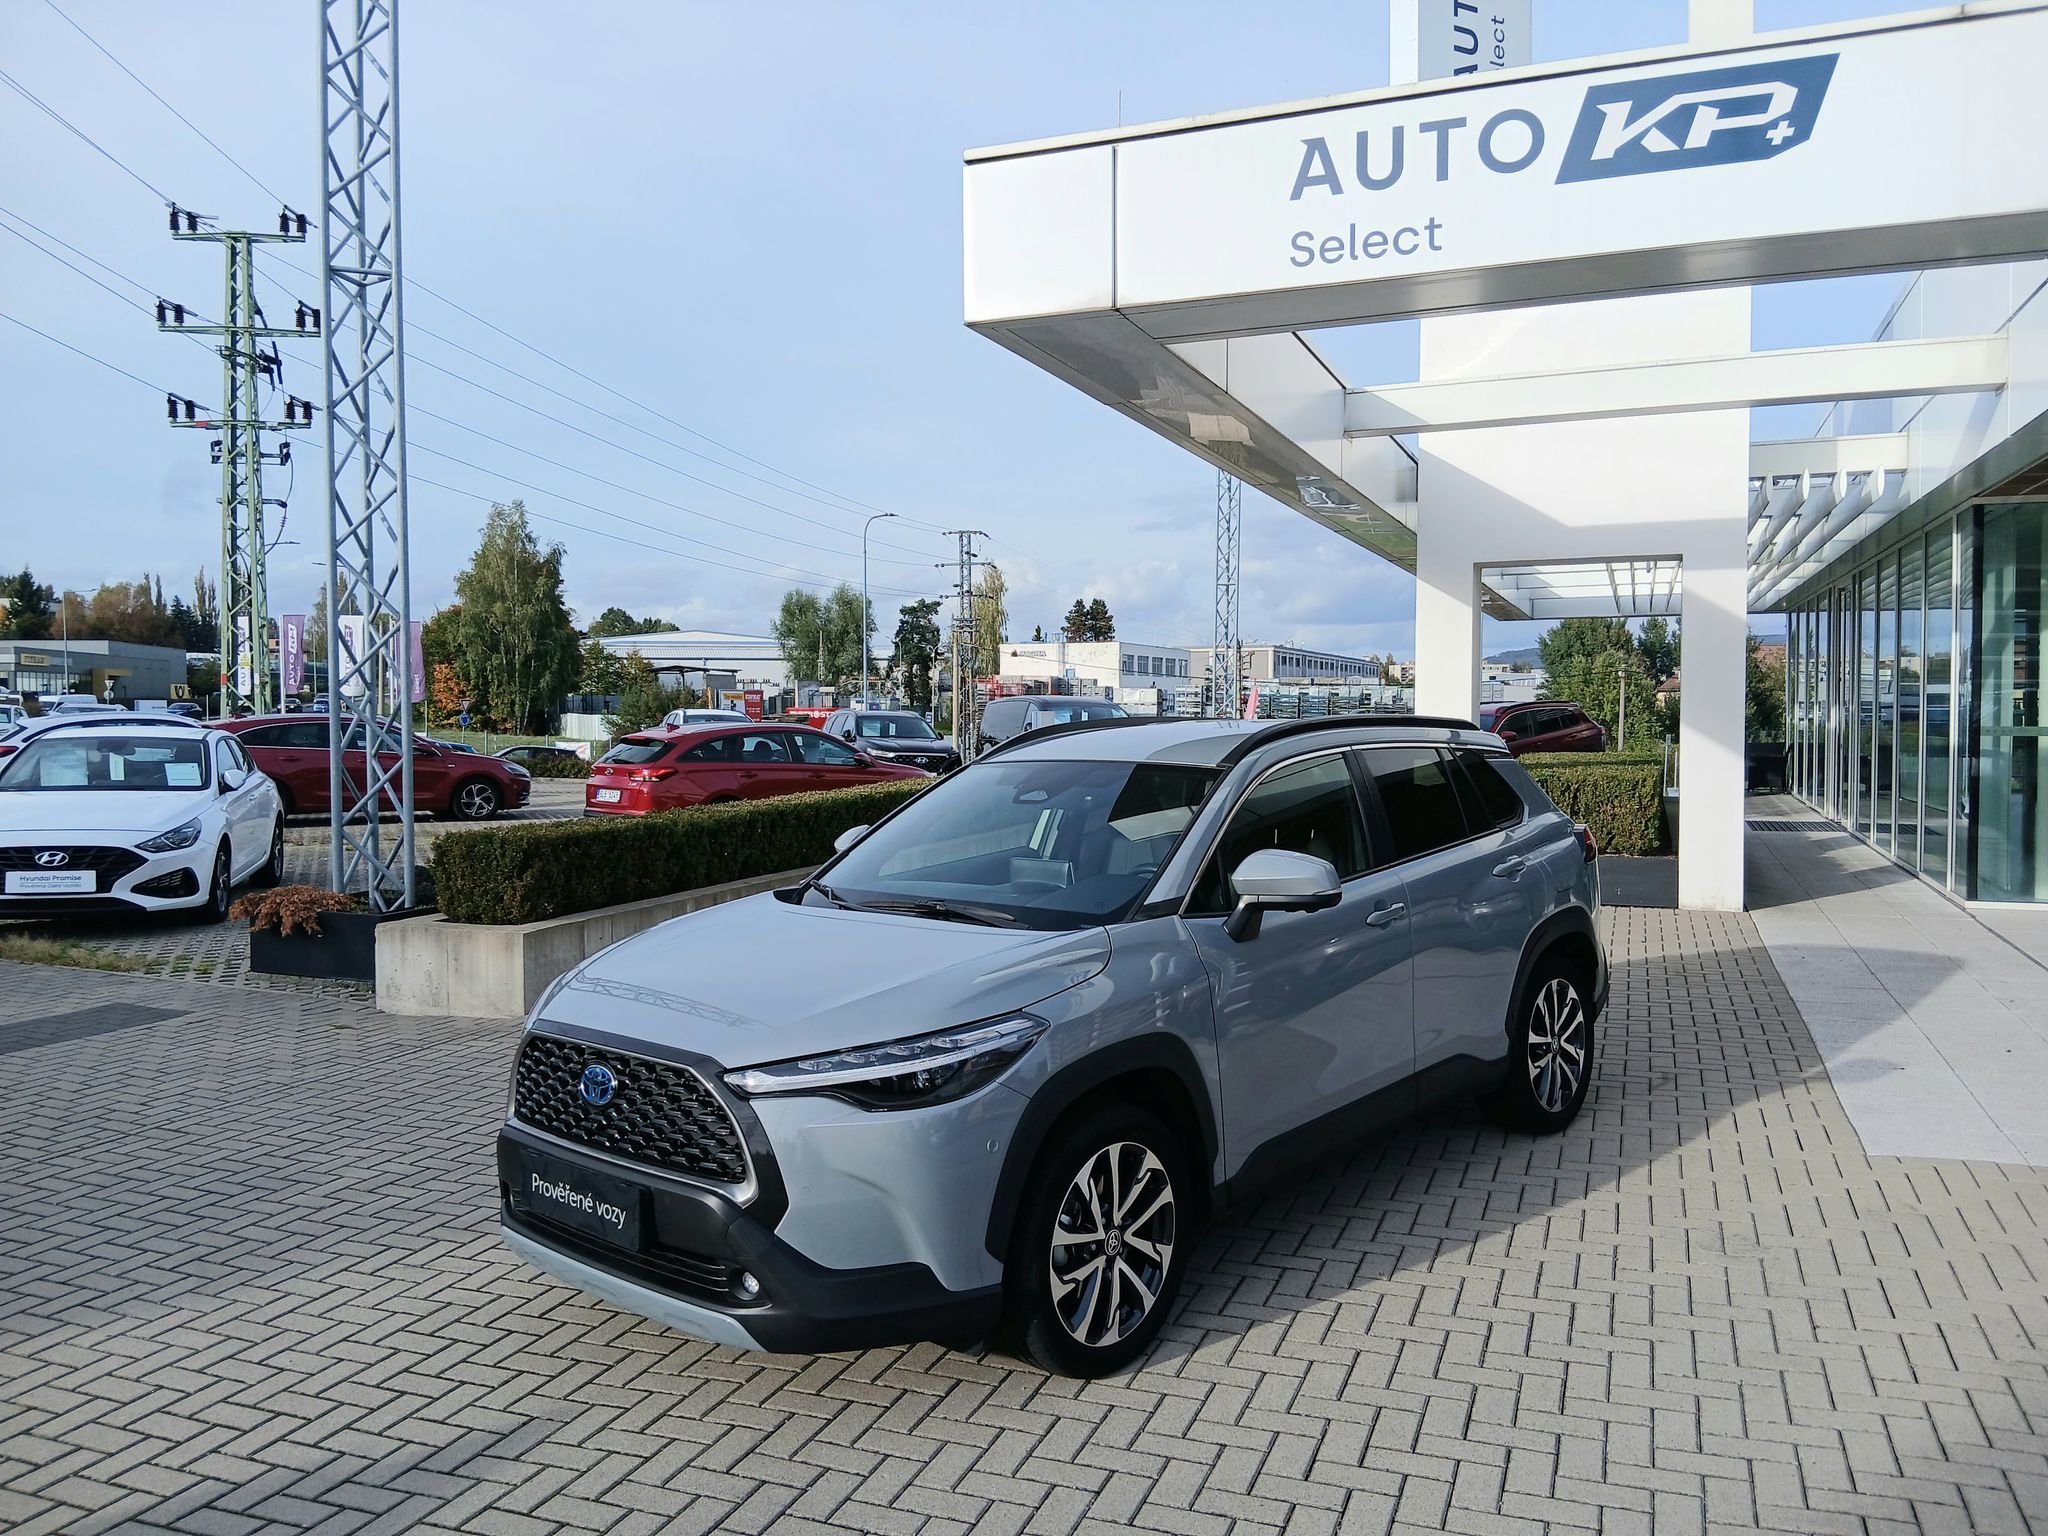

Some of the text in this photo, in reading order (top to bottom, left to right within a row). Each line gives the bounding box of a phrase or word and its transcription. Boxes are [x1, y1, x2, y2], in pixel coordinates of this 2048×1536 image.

[1489, 15, 1505, 71] lect
[1289, 108, 1545, 201] AUTO
[1289, 217, 1443, 267] Select
[532, 1173, 626, 1230] Prověřené vozy
